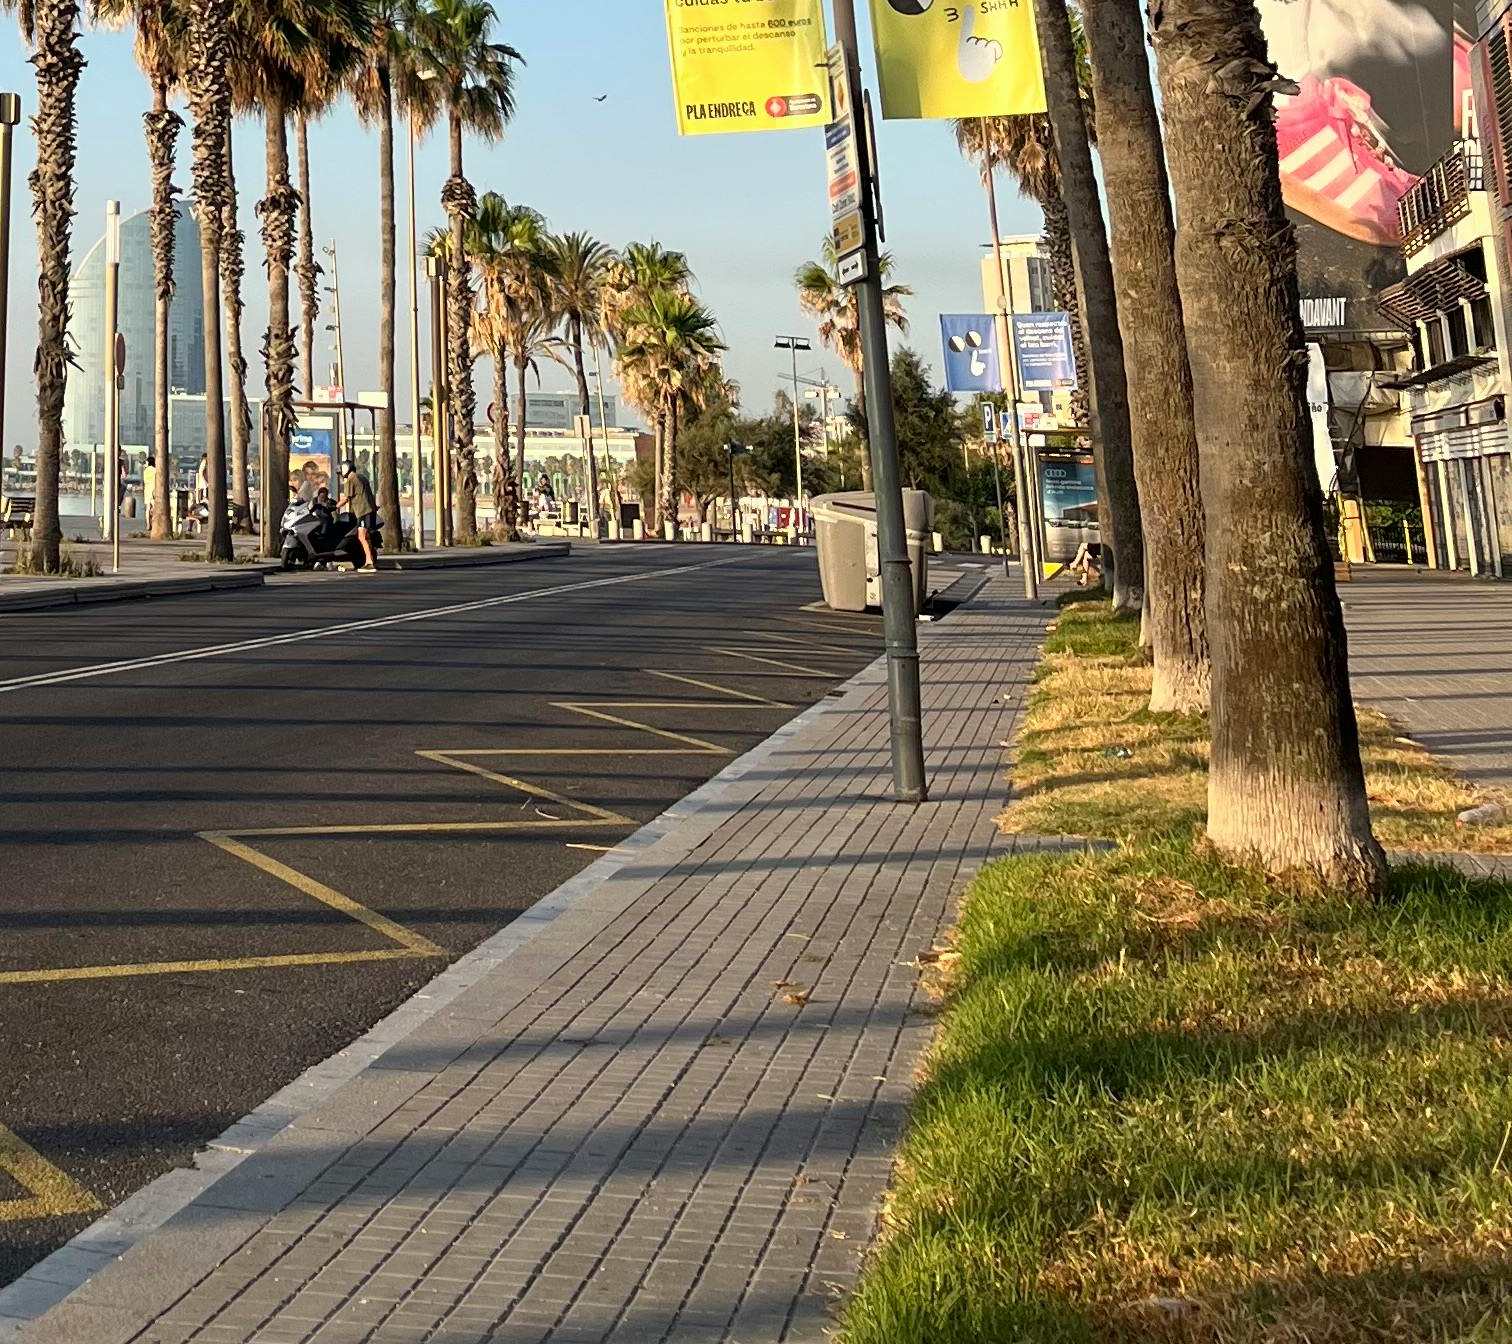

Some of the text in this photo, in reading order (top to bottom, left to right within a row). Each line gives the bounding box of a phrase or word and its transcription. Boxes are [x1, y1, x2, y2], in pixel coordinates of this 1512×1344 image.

[767, 18, 786, 28] 600
[788, 17, 812, 27] euros
[752, 29, 796, 40] descanso
[686, 103, 707, 120] PLA
[1298, 297, 1347, 327] NDAVANT
[984, 405, 991, 429] P
